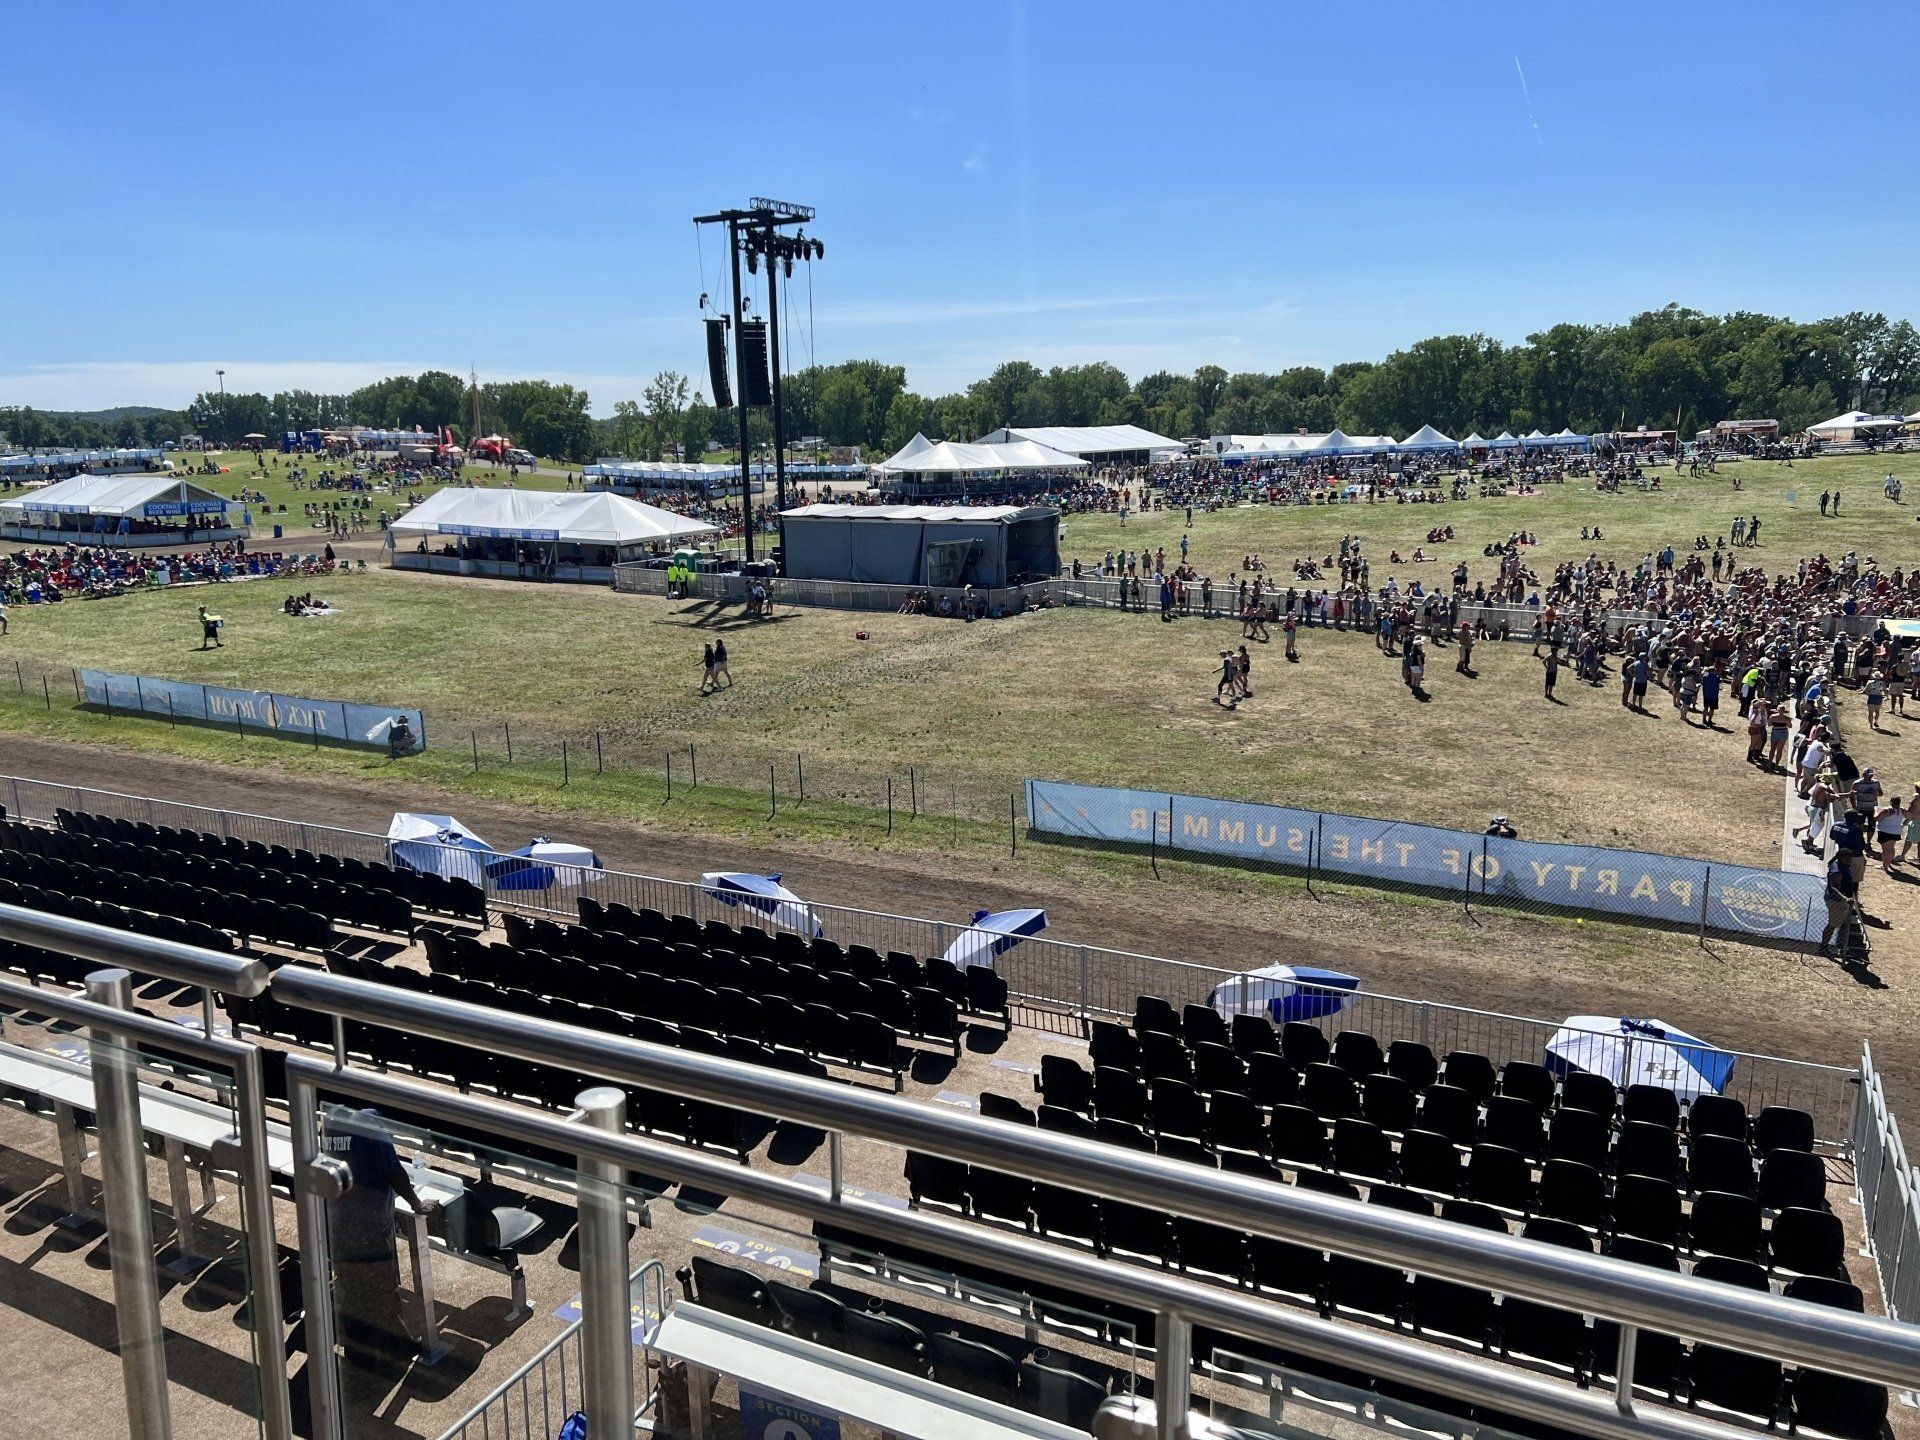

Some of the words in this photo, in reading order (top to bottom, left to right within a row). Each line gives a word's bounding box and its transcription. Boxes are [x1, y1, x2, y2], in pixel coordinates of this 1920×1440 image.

[842, 1186, 866, 1197] OW
[746, 1240, 777, 1253] ROW
[631, 1305, 660, 1320] ROW
[758, 1400, 821, 1427] SECTION
